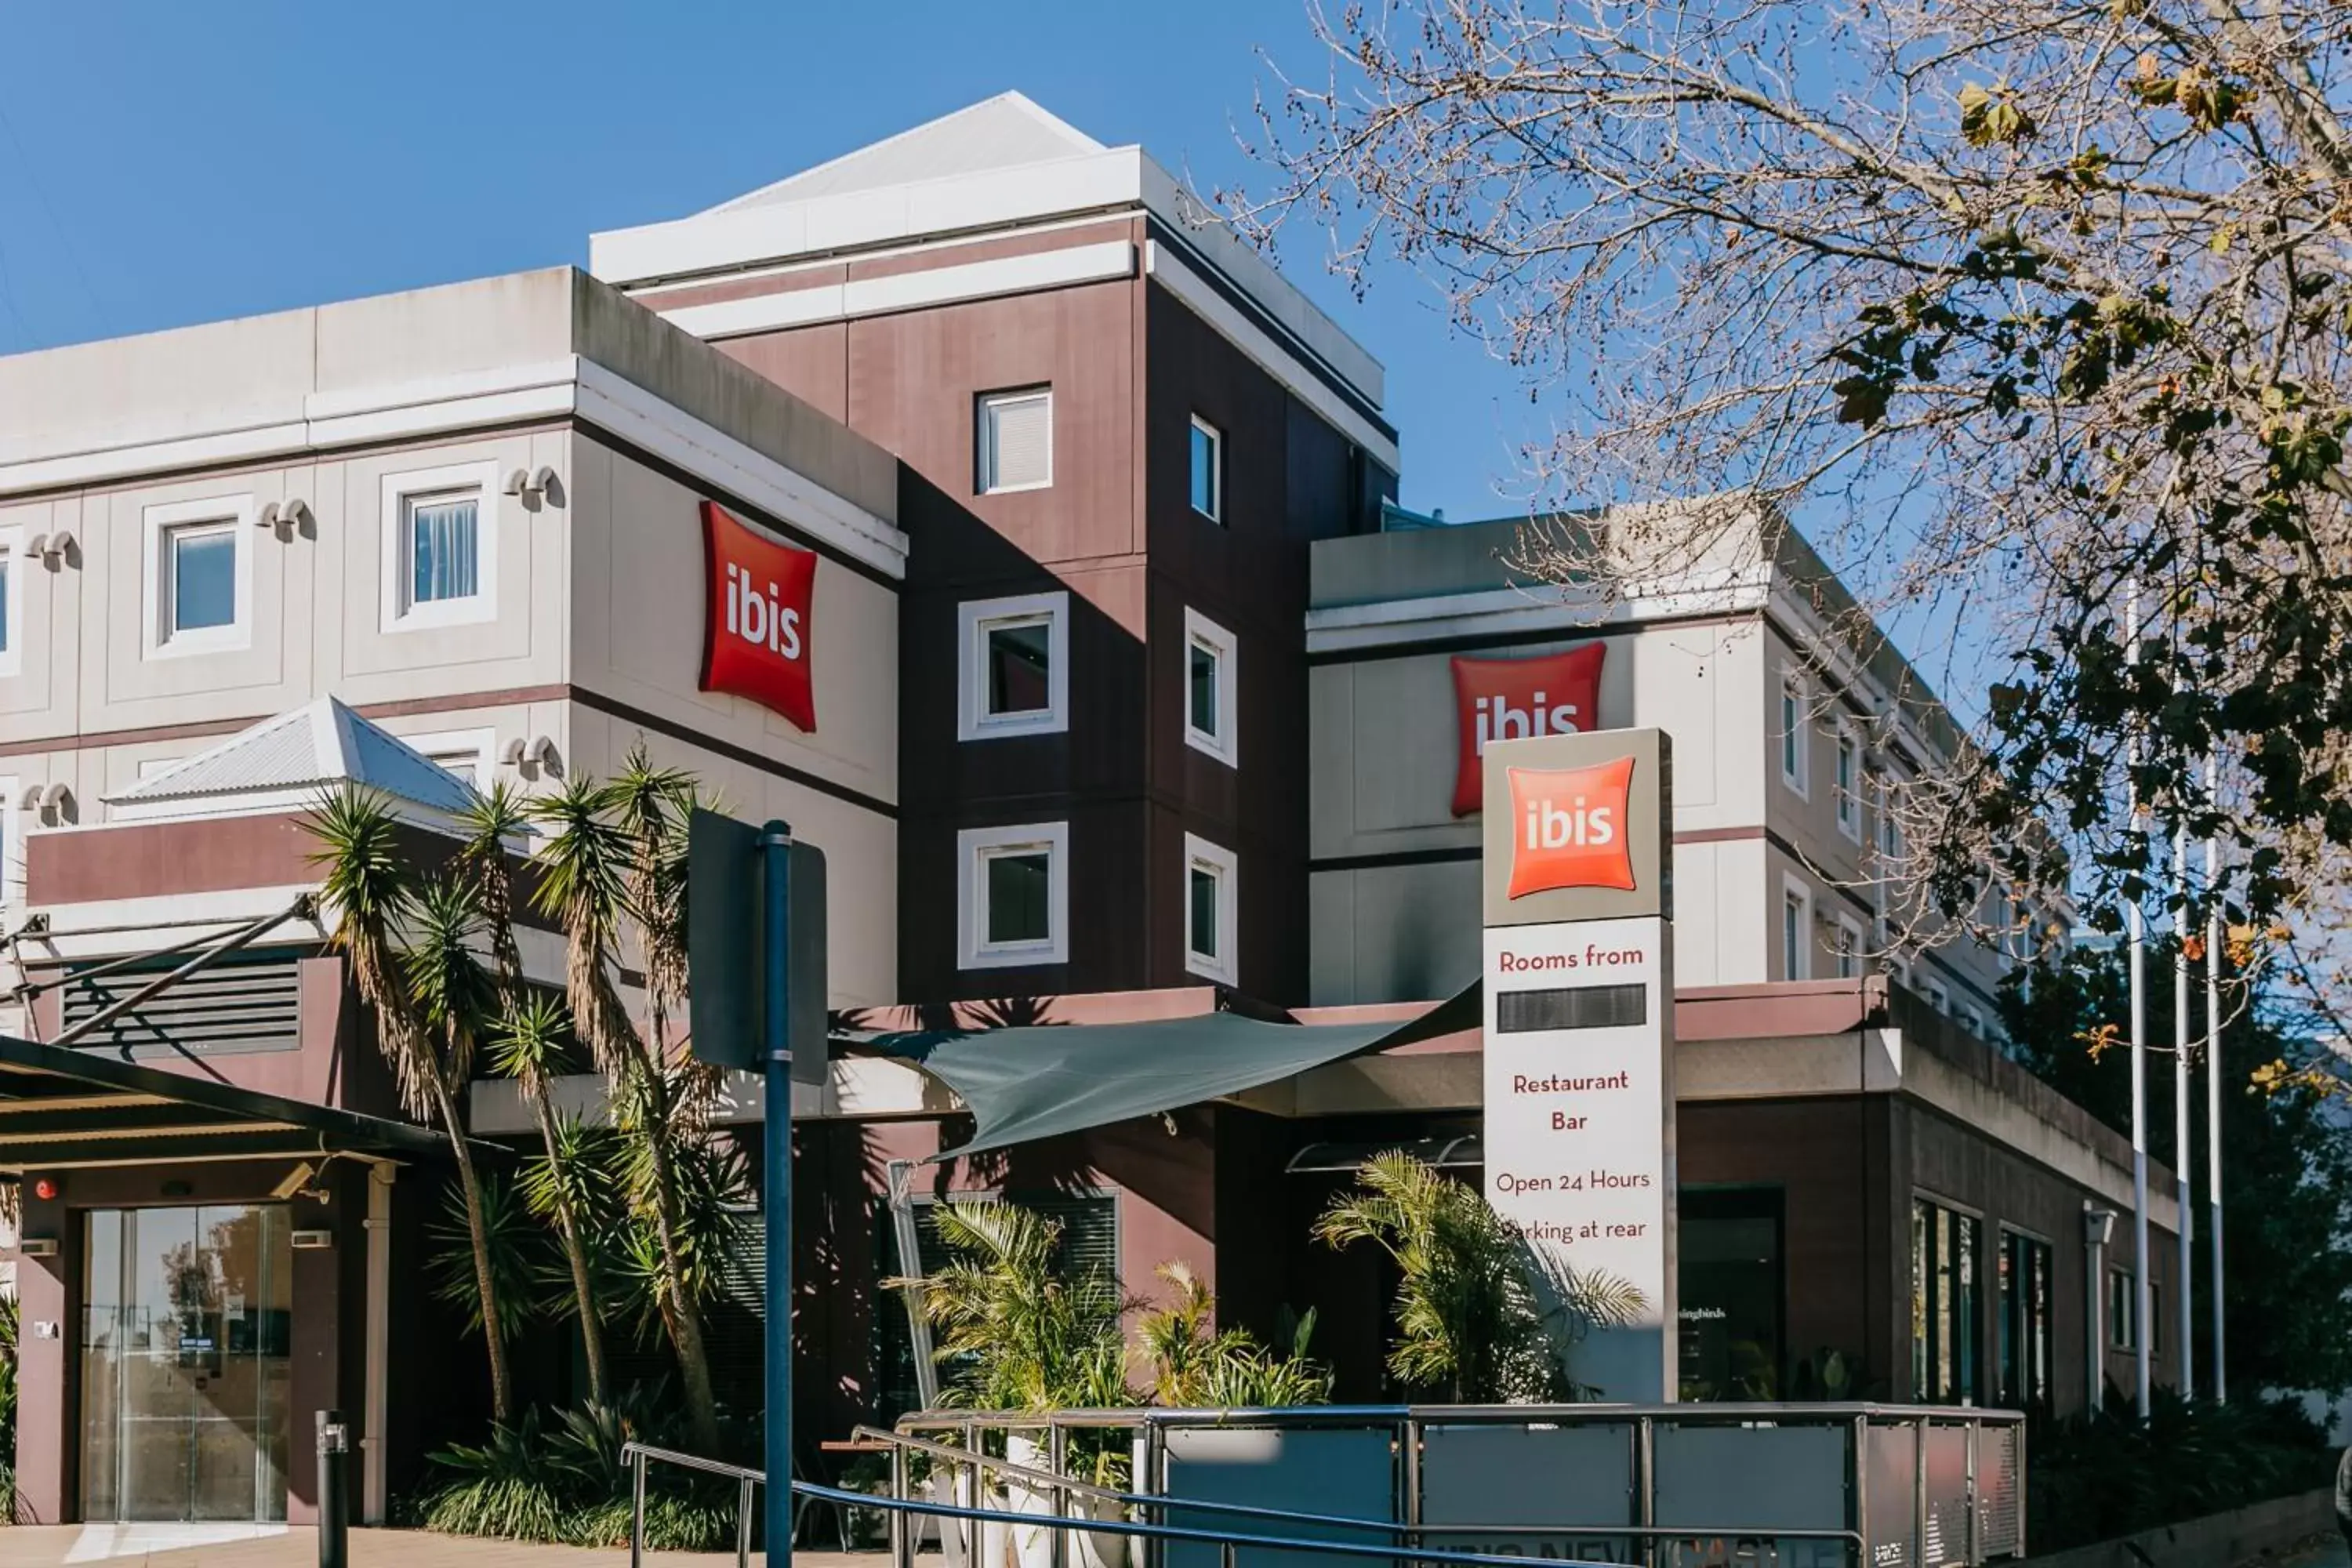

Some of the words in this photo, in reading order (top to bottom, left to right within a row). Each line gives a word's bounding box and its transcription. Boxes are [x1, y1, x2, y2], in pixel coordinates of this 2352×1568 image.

[727, 561, 800, 660] ibis
[1476, 691, 1578, 757] ibis
[1527, 797, 1613, 850] ibis
[1500, 951, 1578, 972] Rooms
[1585, 944, 1643, 966] from
[1514, 1071, 1628, 1094] Restaurant
[1552, 1112, 1588, 1130] Bar
[1497, 1173, 1552, 1196] Open
[1559, 1175, 1583, 1191] 24
[1591, 1170, 1650, 1189] Hours
[1503, 1220, 1573, 1244] arking
[1580, 1220, 1599, 1238] at
[1606, 1223, 1647, 1237] rear
